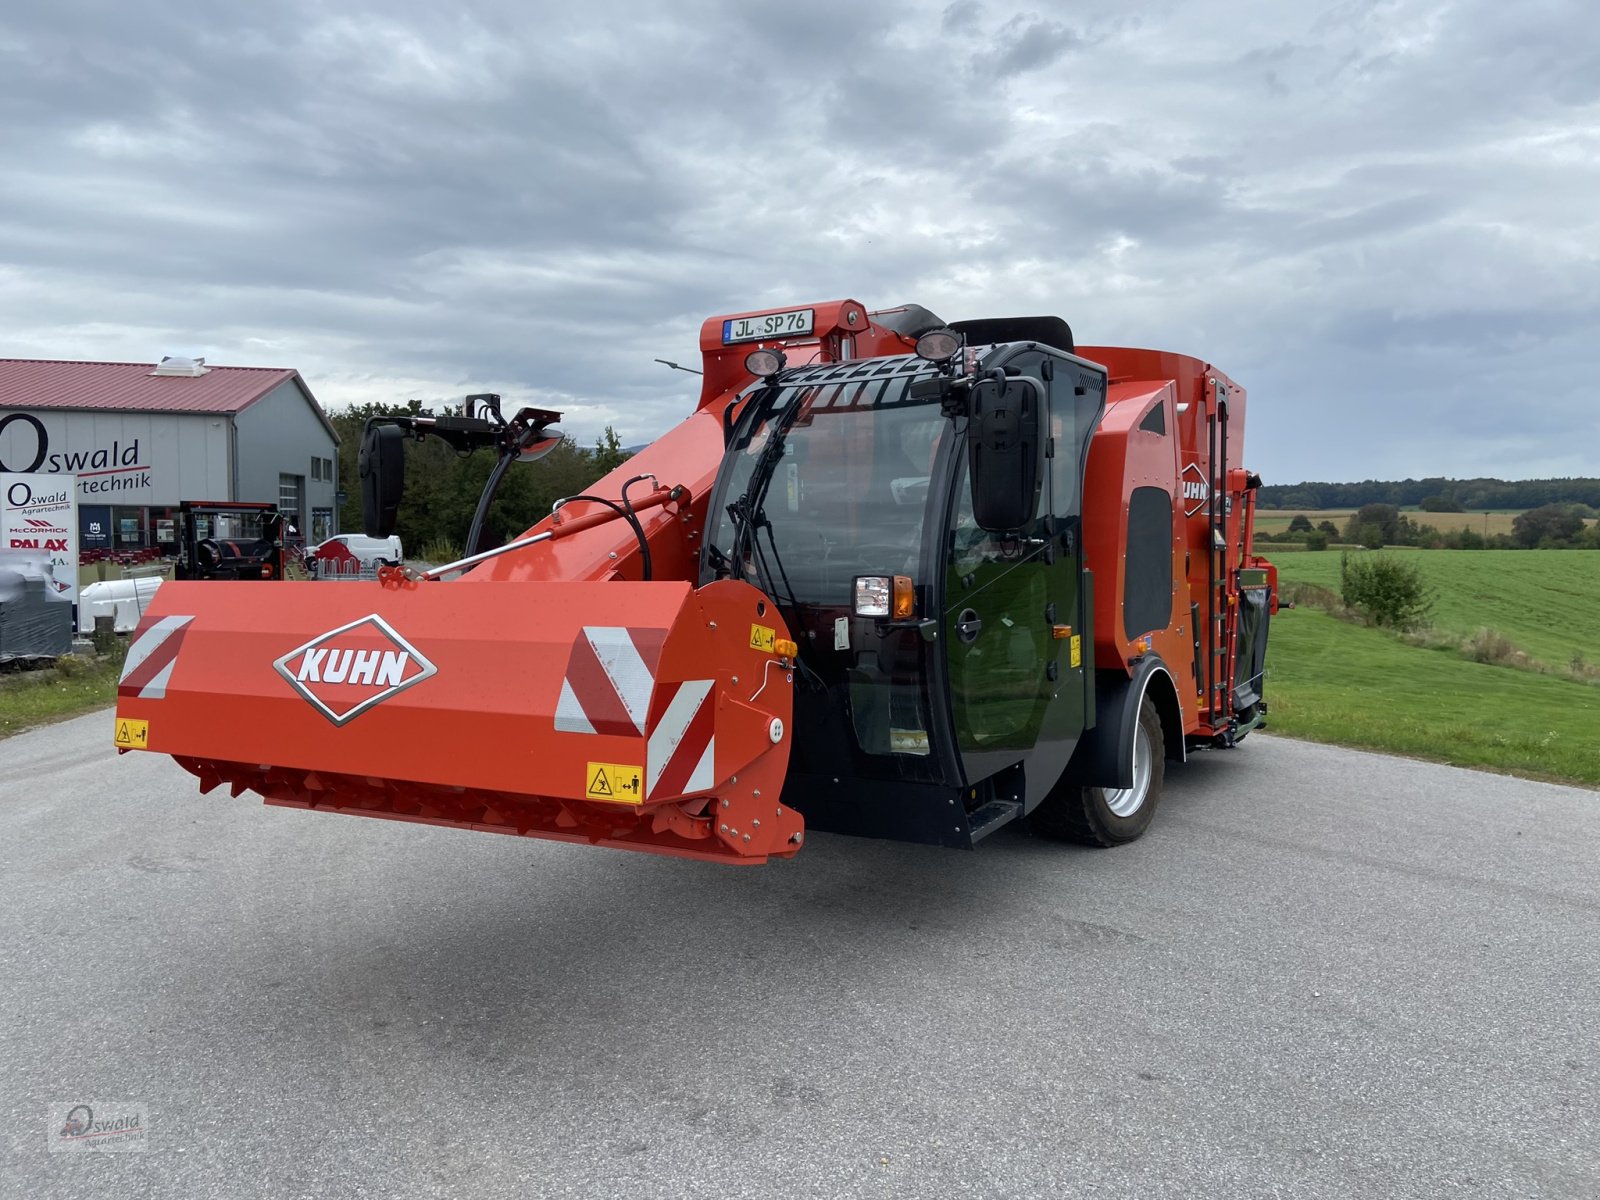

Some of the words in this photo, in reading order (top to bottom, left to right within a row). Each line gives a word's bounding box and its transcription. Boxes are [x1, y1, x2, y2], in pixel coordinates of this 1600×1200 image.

[736, 321, 754, 337] JL
[764, 316, 784, 334] SP
[787, 313, 805, 331] 76
[0, 413, 138, 473] Oswald
[7, 482, 67, 507] Oswald
[1183, 481, 1207, 499] UHN
[21, 504, 71, 516] Agrartechnik
[296, 648, 409, 687] KUHN
